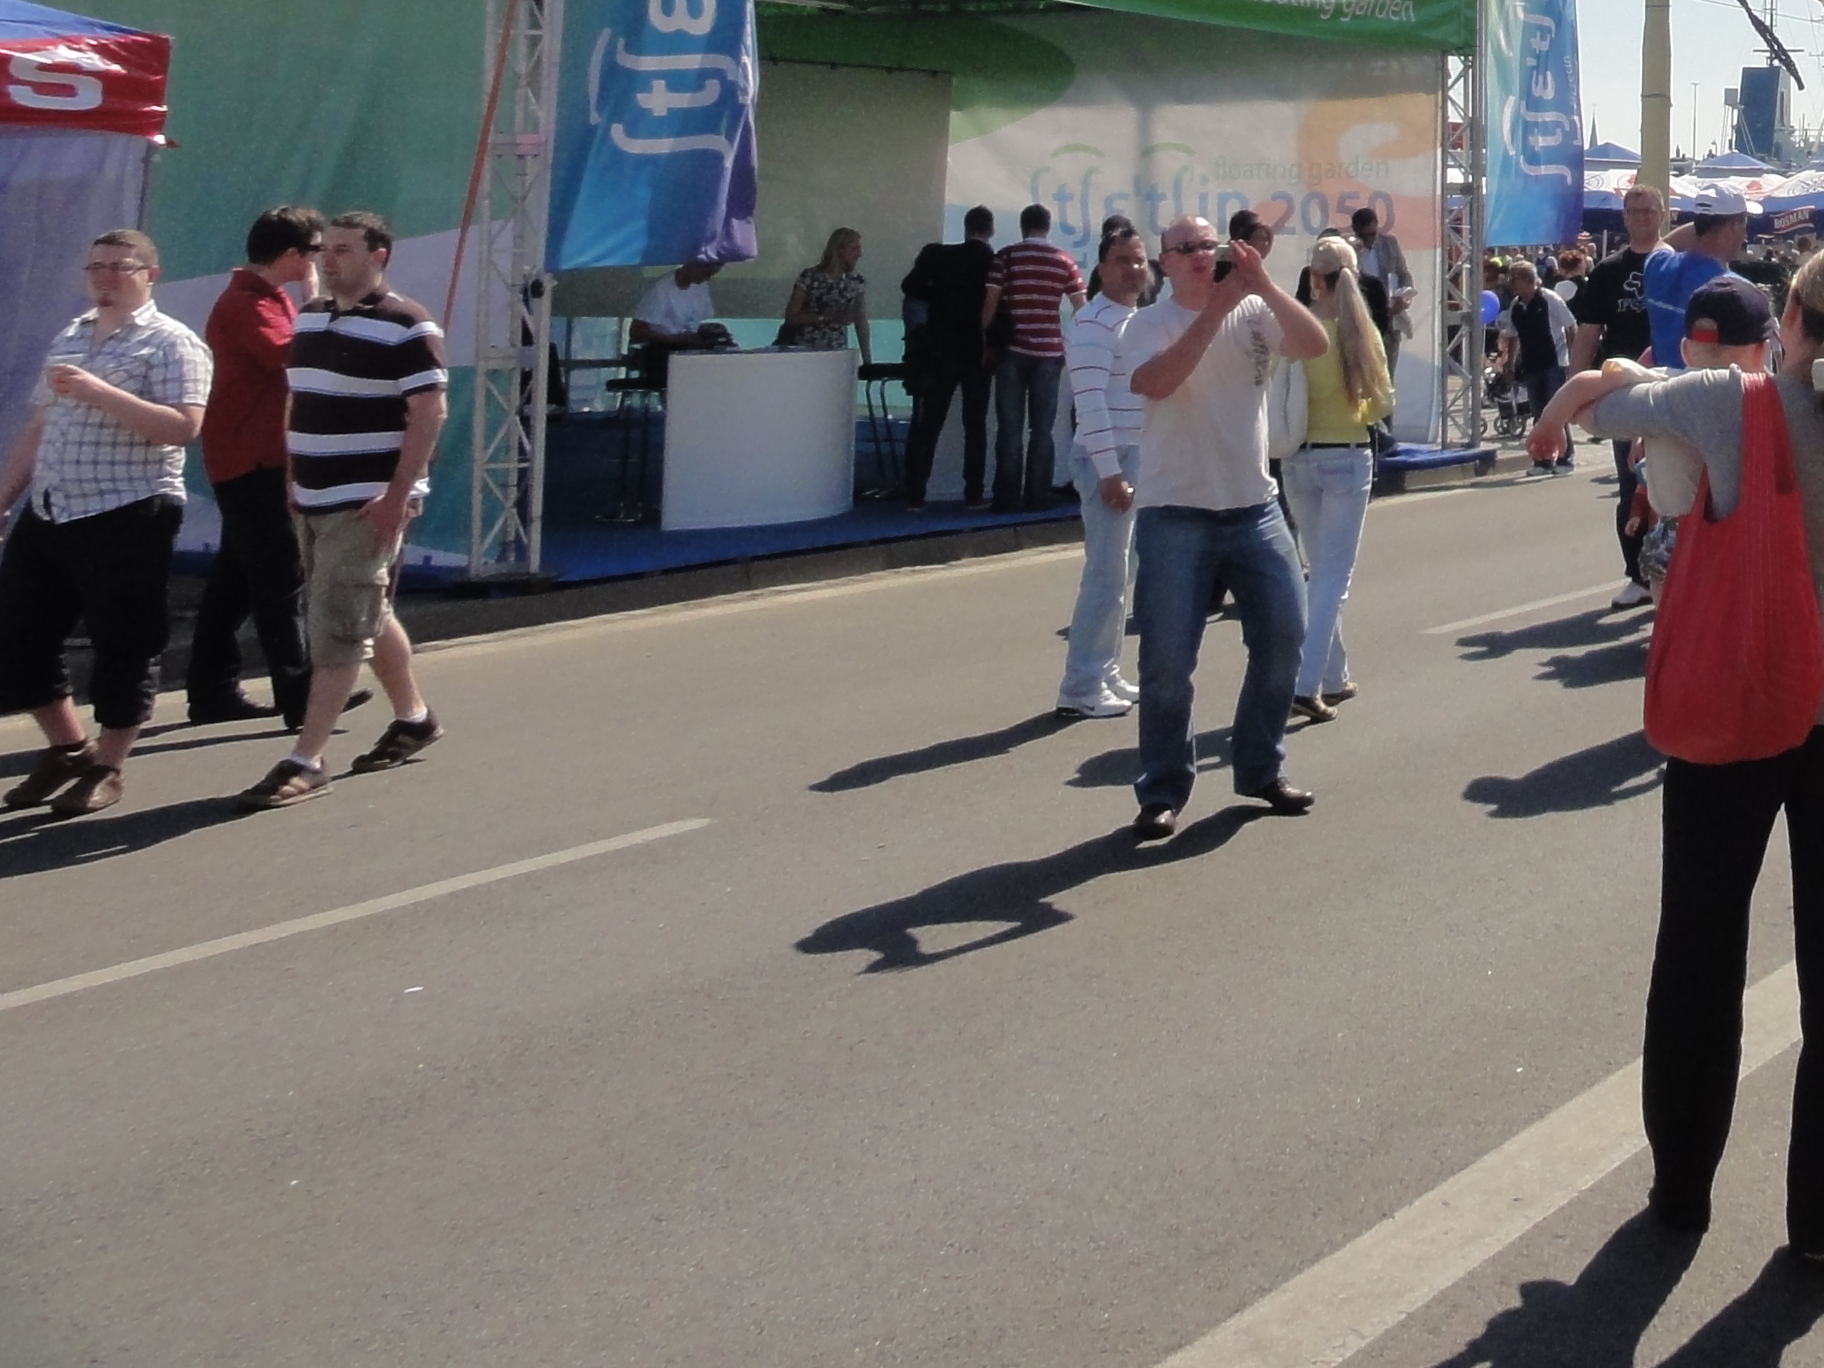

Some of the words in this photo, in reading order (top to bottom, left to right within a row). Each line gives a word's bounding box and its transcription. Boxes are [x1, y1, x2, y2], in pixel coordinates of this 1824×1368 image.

[1214, 156, 1301, 181] floating
[1311, 156, 1390, 185] garden
[1271, 189, 1395, 235] 2050
[1773, 209, 1811, 230] BOSMAN
